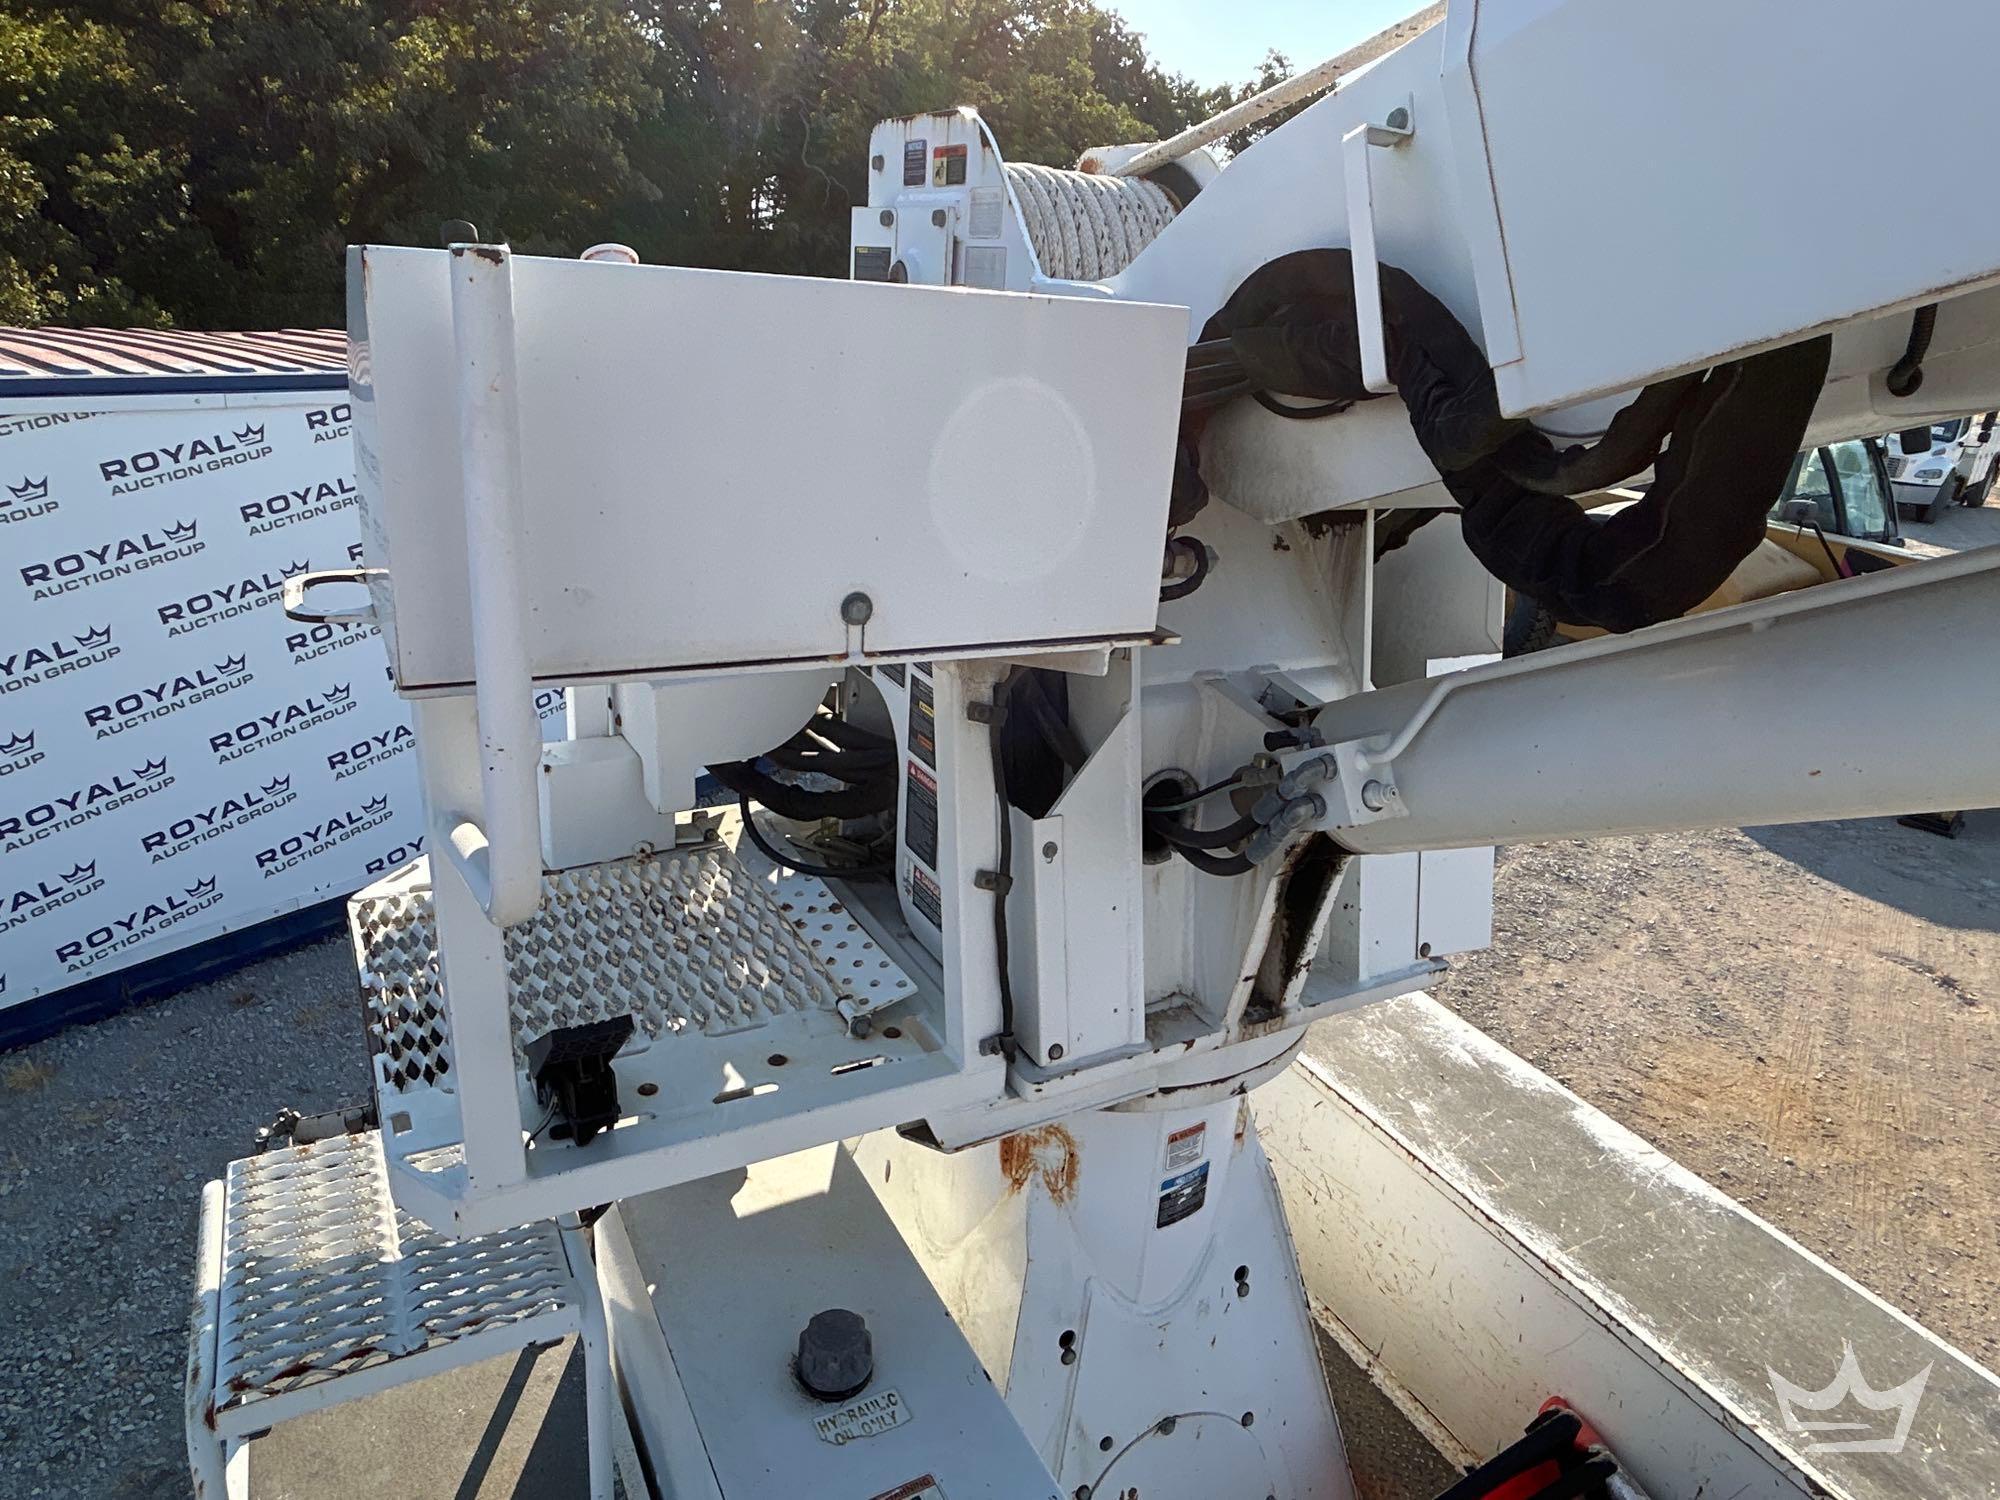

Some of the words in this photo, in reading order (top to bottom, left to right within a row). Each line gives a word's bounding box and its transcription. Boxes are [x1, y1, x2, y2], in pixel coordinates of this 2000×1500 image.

[0, 412, 70, 436] CTION
[99, 435, 237, 481] ROYAL
[112, 464, 203, 496] AUCTION
[206, 446, 272, 471] GROUP
[0, 501, 59, 523] ROUP
[240, 478, 356, 523] ROYAL
[249, 505, 327, 536] AUCTION
[20, 534, 166, 586] ROYAL
[34, 564, 131, 601] AUCTION
[134, 542, 205, 570] GROUP
[157, 573, 282, 625] ROYAL
[169, 601, 252, 638] AUCTION
[0, 641, 79, 676] YAL
[44, 646, 121, 679] GROUP
[295, 630, 367, 665] AUCTION
[84, 670, 218, 727] ROYAL
[97, 699, 185, 740] AUCTION
[189, 674, 253, 704] GROUP
[209, 698, 325, 753] ROYAL
[219, 725, 296, 765] AUCTION
[299, 701, 357, 730] GROUP
[327, 725, 413, 770] ROYA
[0, 752, 45, 776] OUP
[336, 744, 403, 781] AUCTION
[0, 776, 137, 840] ROYAL
[5, 806, 102, 853] AUCTION
[105, 776, 175, 811] GROUP
[141, 792, 265, 853] ROYAL
[152, 821, 234, 864] AUCTION
[237, 792, 297, 824] GROUP
[255, 811, 364, 868] ROYAL
[264, 838, 337, 879] AUCTION
[339, 811, 393, 841] GROUP
[365, 836, 424, 874] ROY
[30, 879, 105, 917] GROUP
[56, 896, 188, 963] ROYAL
[67, 926, 156, 974] AUCTION
[159, 893, 223, 929] GROUP
